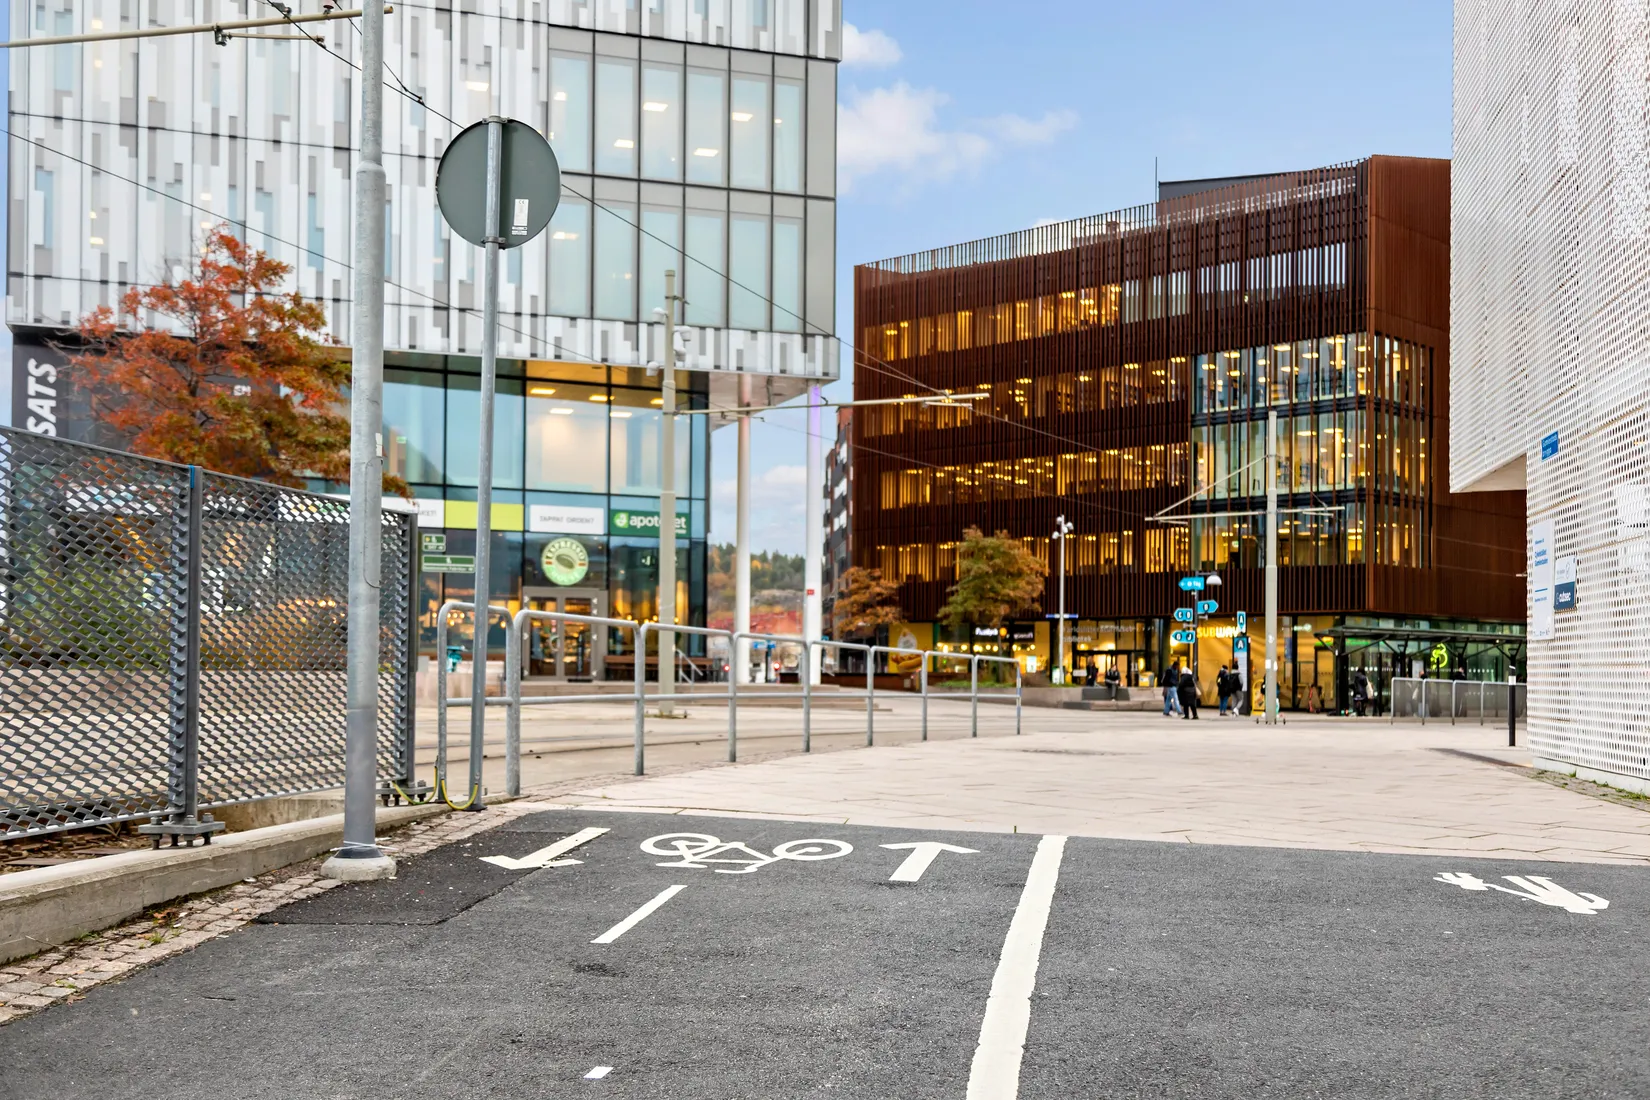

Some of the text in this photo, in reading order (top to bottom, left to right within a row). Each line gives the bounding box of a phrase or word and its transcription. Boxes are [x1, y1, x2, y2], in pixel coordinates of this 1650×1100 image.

[27, 358, 57, 437] SATS
[629, 515, 687, 528] apotet
[545, 540, 586, 560] ESPRESSO
[1238, 640, 1244, 649] A
